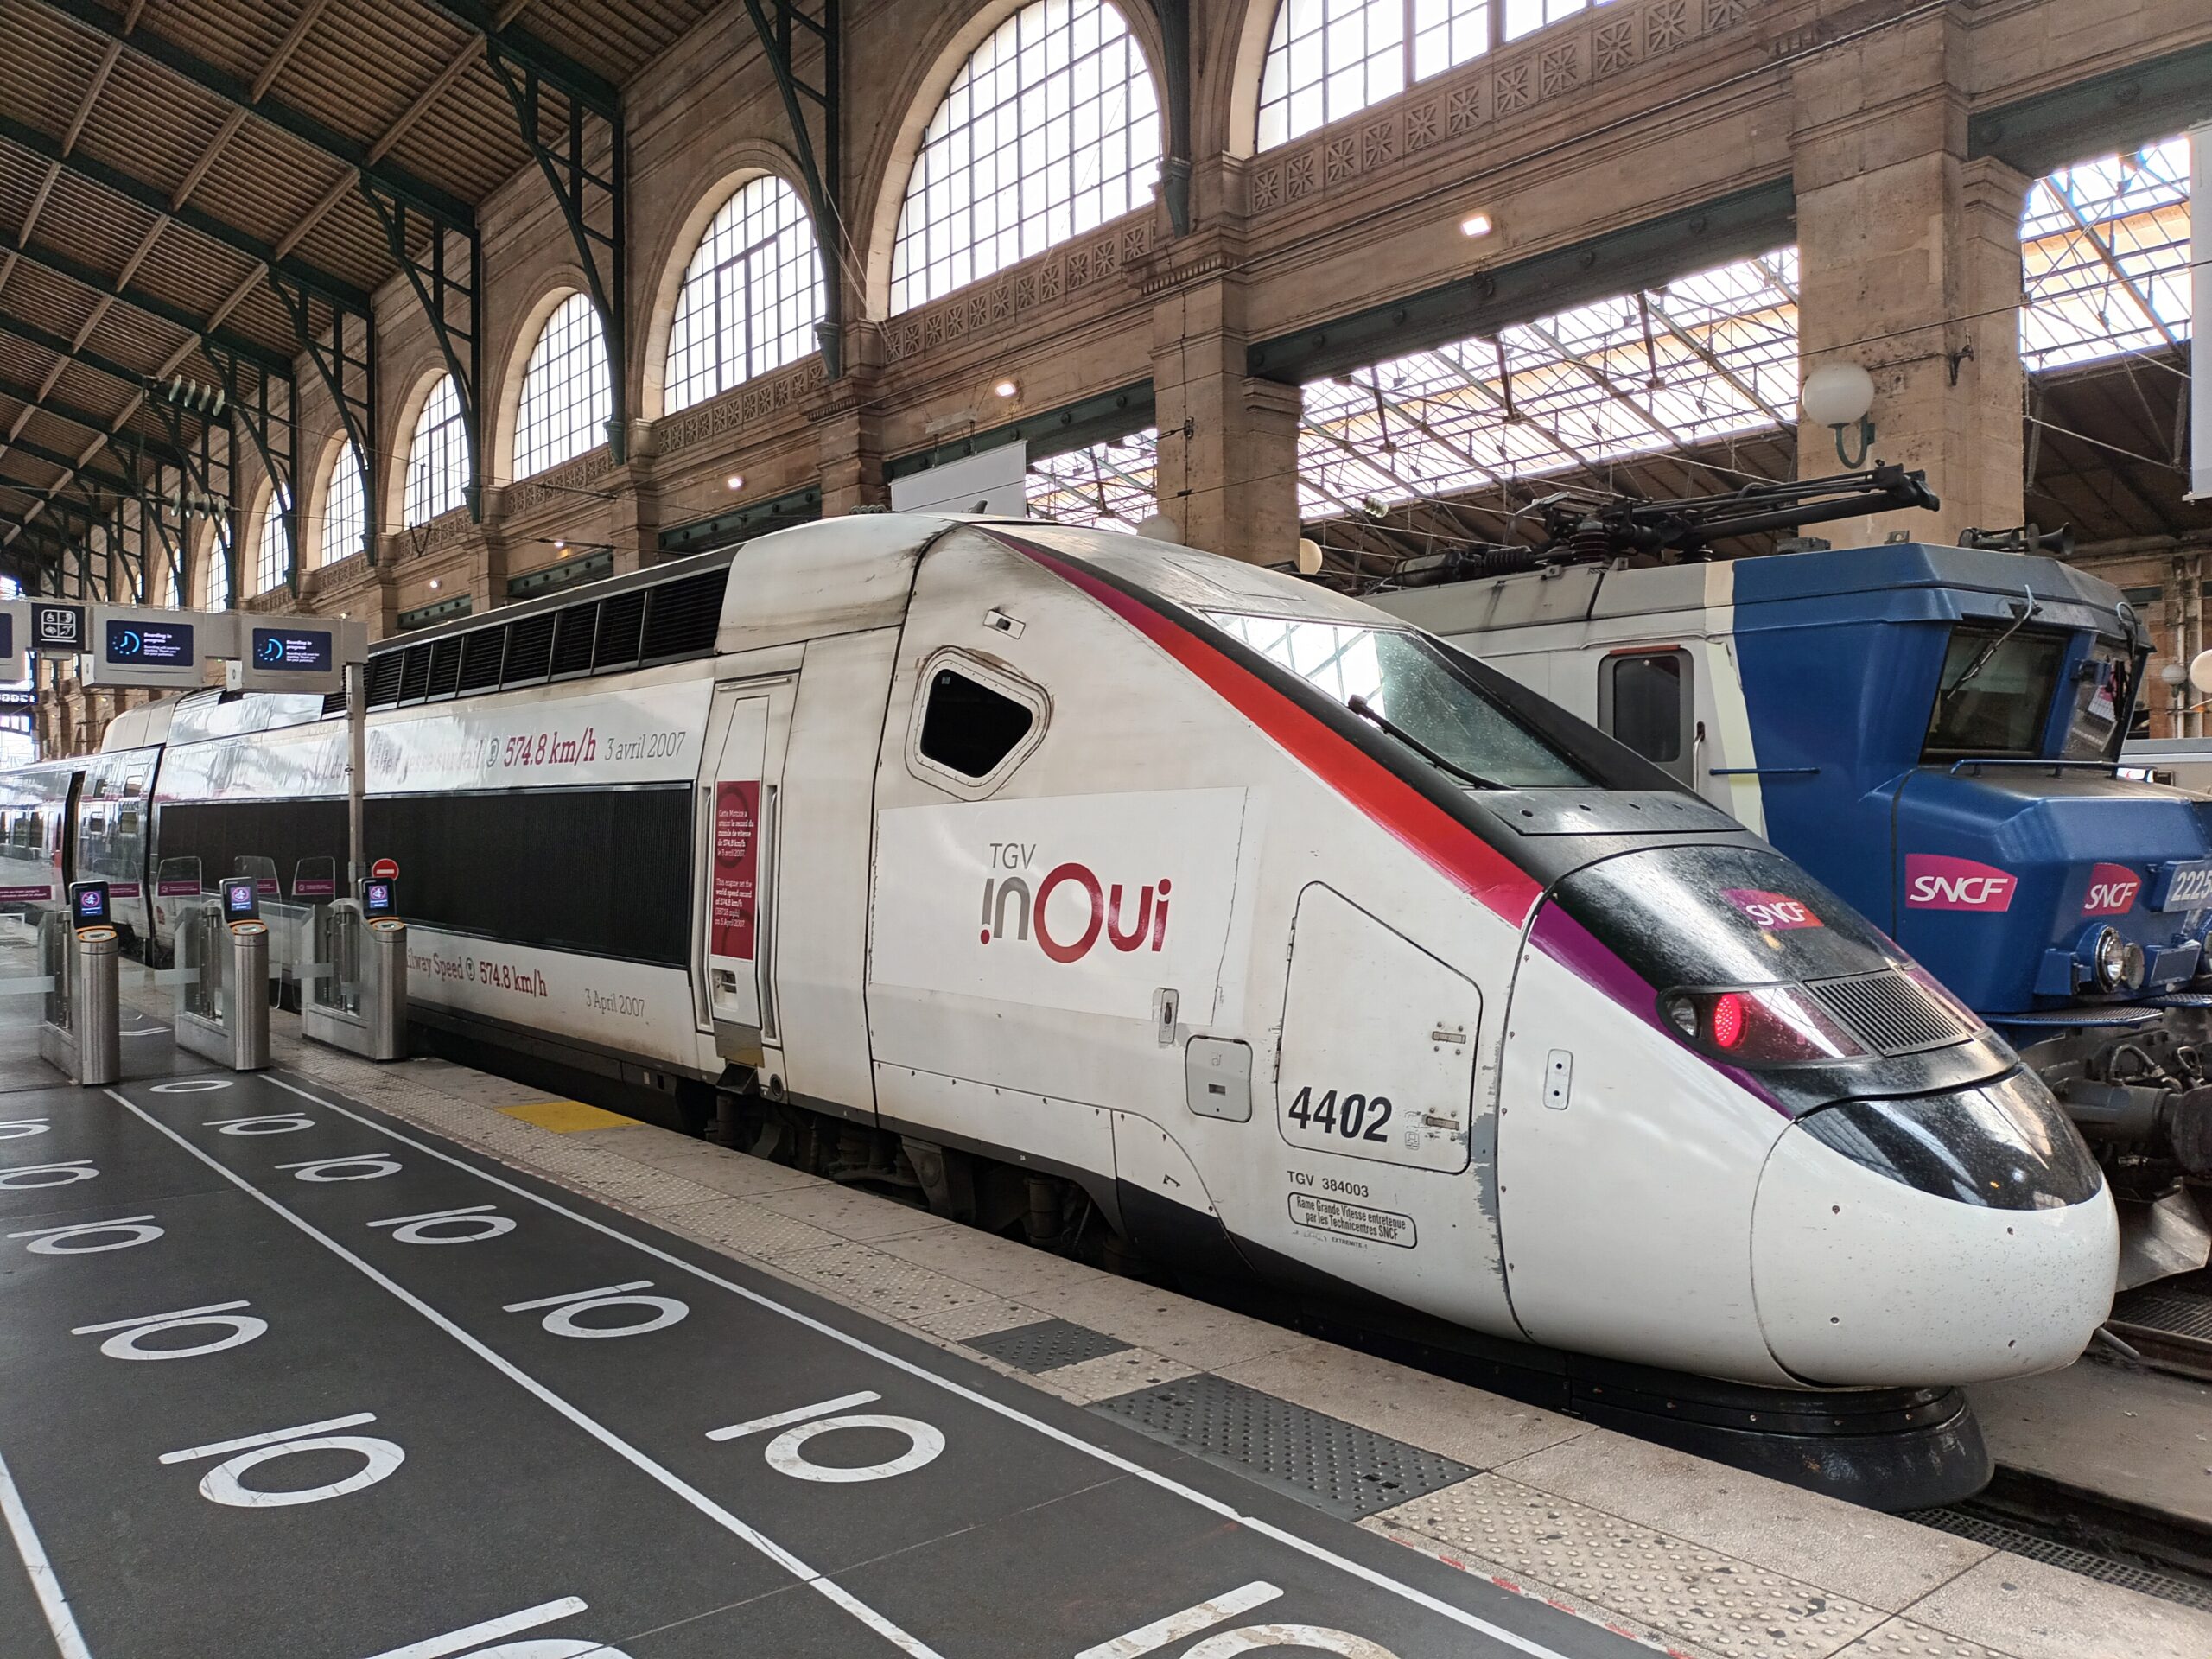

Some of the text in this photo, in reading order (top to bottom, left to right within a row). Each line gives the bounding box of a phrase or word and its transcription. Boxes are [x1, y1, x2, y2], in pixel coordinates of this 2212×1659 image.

[503, 733, 547, 767] 574.8
[548, 726, 597, 767] km/h
[604, 731, 686, 761] 3 avril 2007
[989, 842, 1037, 870] TGV
[1909, 875, 2009, 904] SNCF
[2083, 869, 2212, 910] SNCF 2225
[1745, 900, 1806, 925] SNCF
[407, 947, 548, 998] ilway Speed 574.8 km/h
[584, 988, 645, 1018] 3 April 2007
[1287, 1085, 1393, 1143] 4402
[1287, 1170, 1370, 1198] TGV 384003
[1296, 1195, 1406, 1230] Rame Grande Vitesse entretenue
[1306, 1211, 1316, 1224] par
[1318, 1211, 1328, 1225] les
[1329, 1214, 1377, 1236] Technicentres
[1378, 1226, 1399, 1241] SNCF
